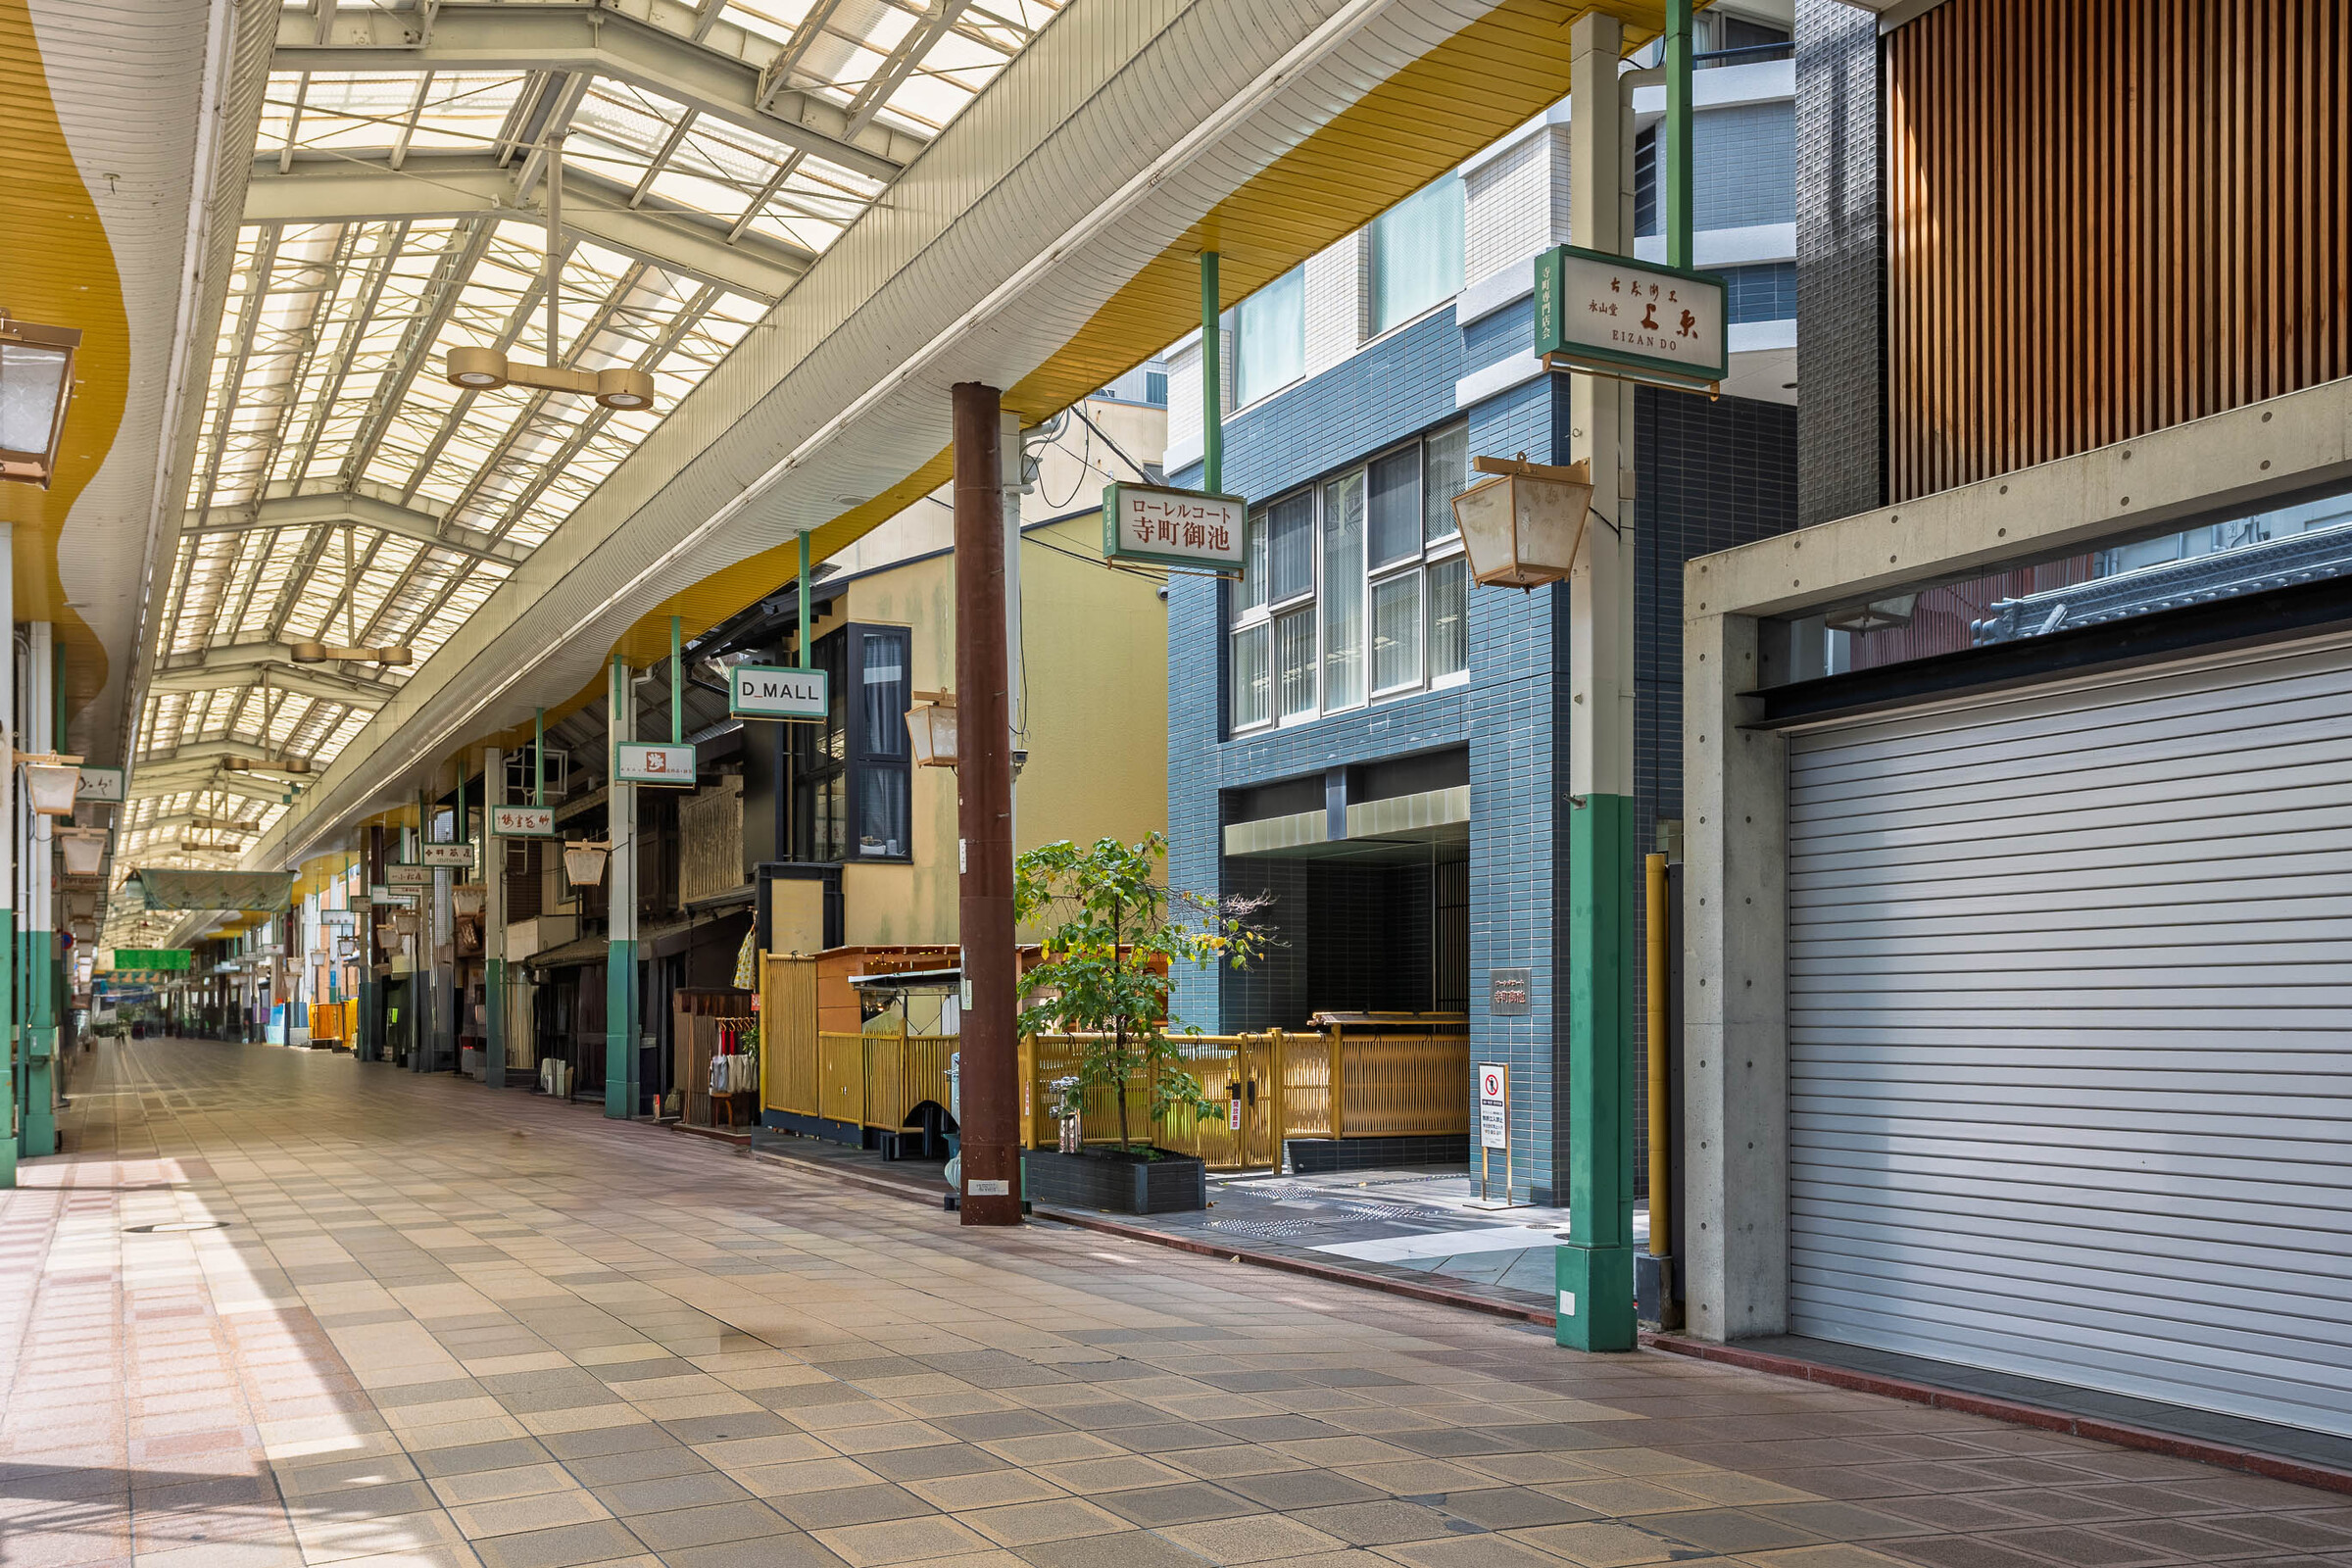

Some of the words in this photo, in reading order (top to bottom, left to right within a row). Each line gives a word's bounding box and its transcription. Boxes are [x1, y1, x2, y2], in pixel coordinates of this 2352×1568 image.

[1589, 299, 1619, 317] 永山堂
[1133, 500, 1231, 524] ローレルコート
[1132, 516, 1231, 552] 寺町御池
